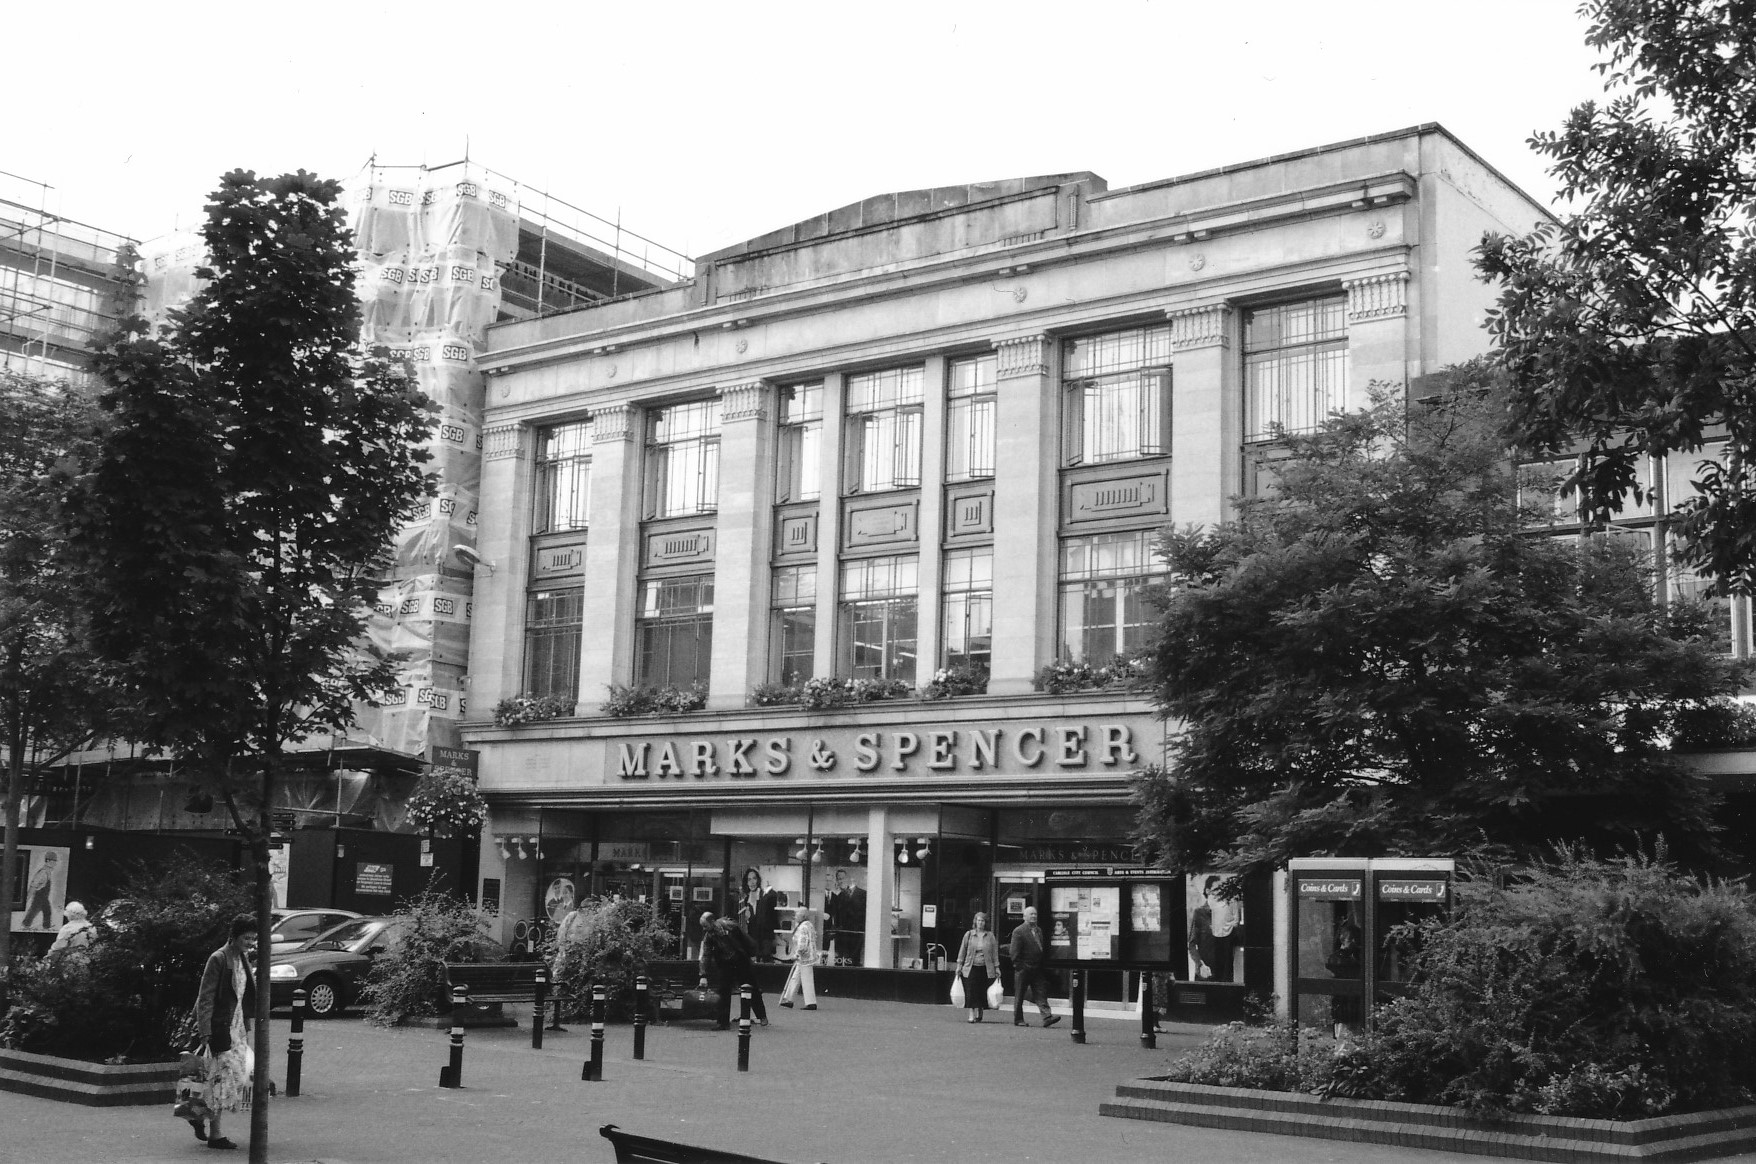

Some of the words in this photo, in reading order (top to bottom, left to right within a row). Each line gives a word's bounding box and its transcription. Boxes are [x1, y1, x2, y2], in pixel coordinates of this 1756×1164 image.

[390, 190, 413, 205] SGB
[457, 184, 476, 197] SGB
[488, 191, 505, 207] SGB
[381, 268, 403, 283] SGB
[442, 345, 467, 360] SGB
[441, 425, 464, 442] SGB
[411, 505, 430, 520] SGB
[401, 600, 419, 614] SGB
[435, 599, 453, 614] SGB
[439, 750, 470, 761] MARKS
[617, 738, 791, 779] MARKS
[810, 739, 837, 771] &
[853, 724, 1136, 771] SPENCER
[1019, 850, 1064, 860] MARKS
[1300, 883, 1320, 893] Coins
[1320, 884, 1327, 893] &
[1327, 883, 1348, 893] Cards
[1382, 884, 1403, 894] Coins
[1402, 885, 1410, 894] &
[1410, 884, 1432, 894] Cards
